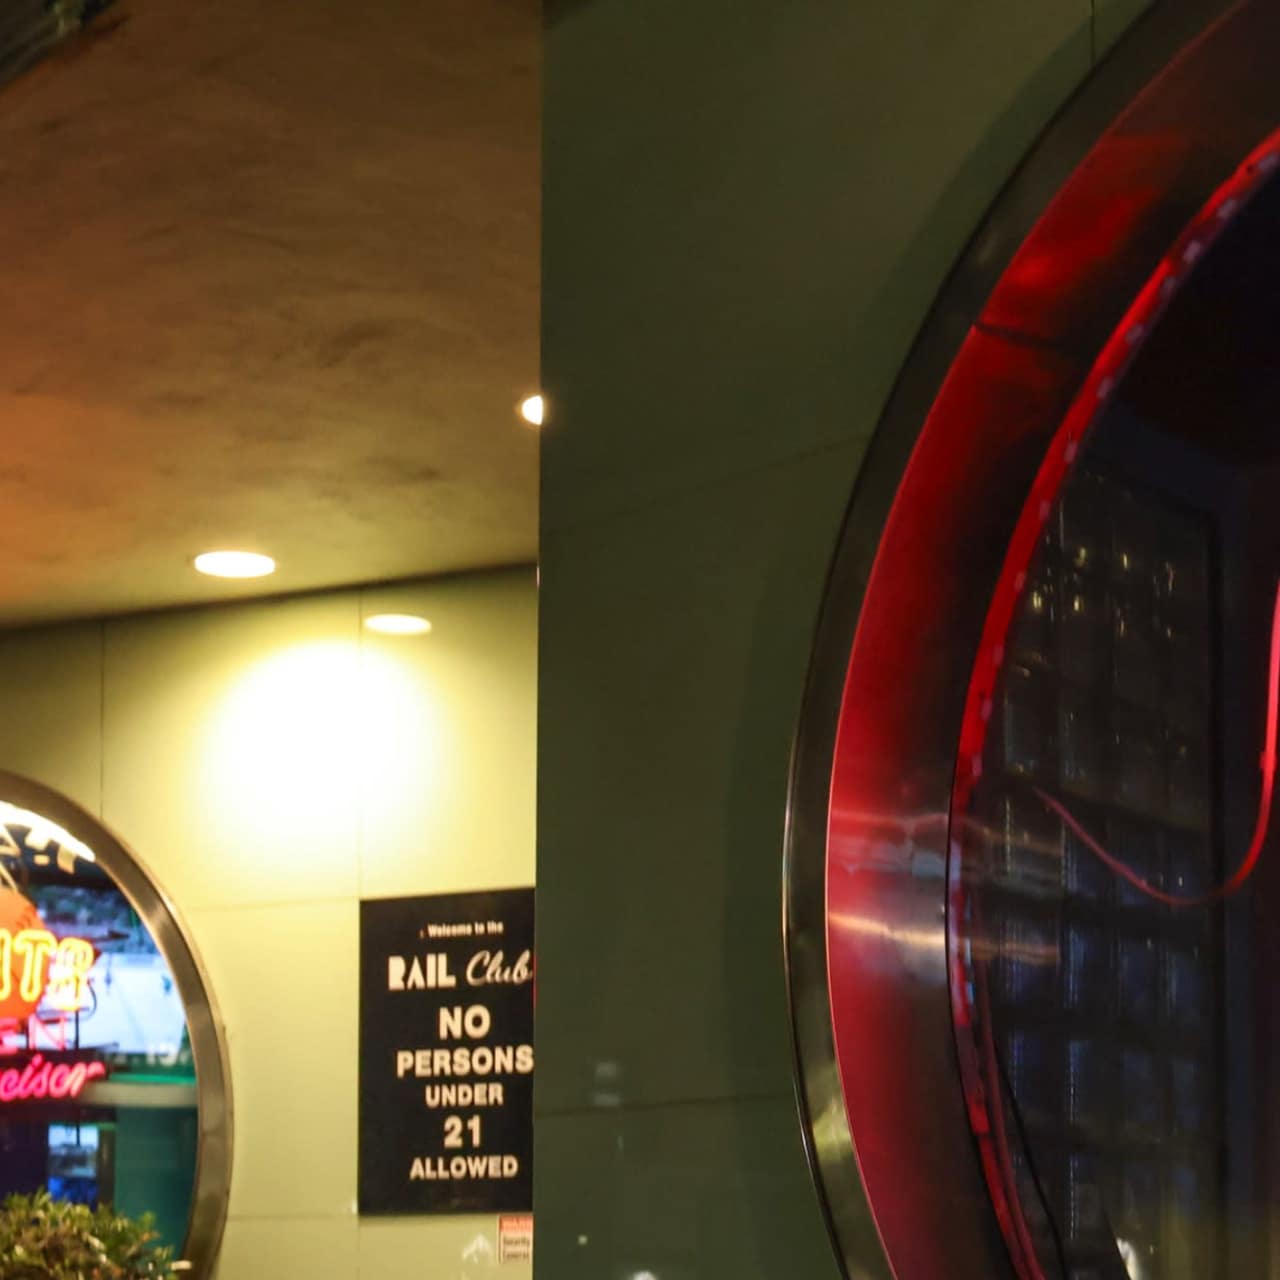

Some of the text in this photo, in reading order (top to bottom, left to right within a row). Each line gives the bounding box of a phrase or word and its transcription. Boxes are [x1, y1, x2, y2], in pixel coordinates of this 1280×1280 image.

[388, 949, 533, 991] RAIL Club
[439, 1004, 491, 1040] NO
[397, 1045, 534, 1078] PERSONS
[425, 1083, 503, 1107] UNDER
[444, 1115, 481, 1148] 21
[410, 1155, 518, 1180] ALLOWED
